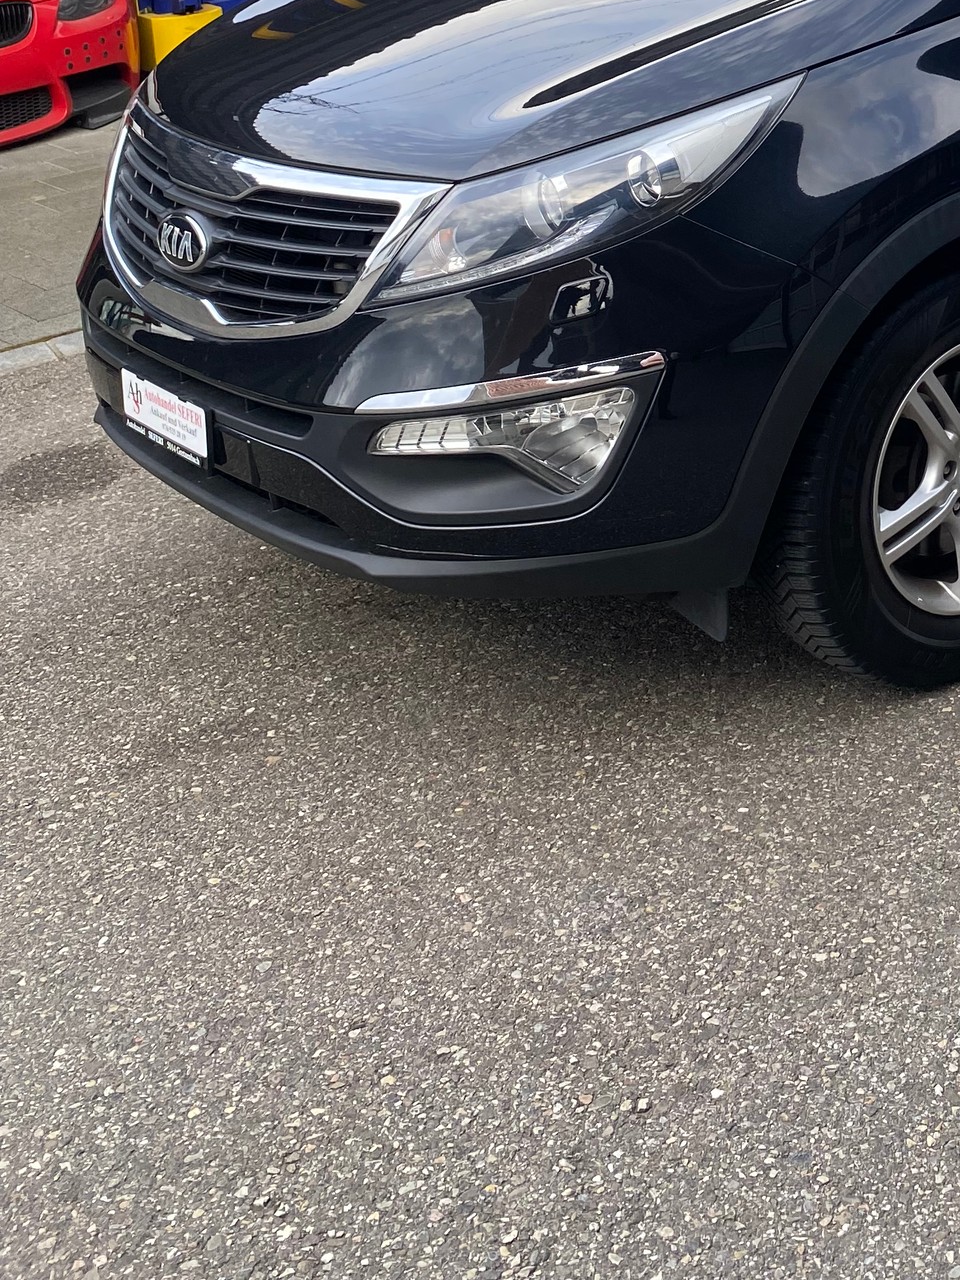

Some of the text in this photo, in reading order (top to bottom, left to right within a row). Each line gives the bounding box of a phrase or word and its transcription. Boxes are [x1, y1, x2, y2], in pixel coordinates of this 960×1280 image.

[160, 222, 194, 263] KIA
[144, 387, 203, 429] Autohandel SEFERI
[151, 405, 197, 438] Ankauf und Verkauf
[148, 431, 164, 446] SEFERI
